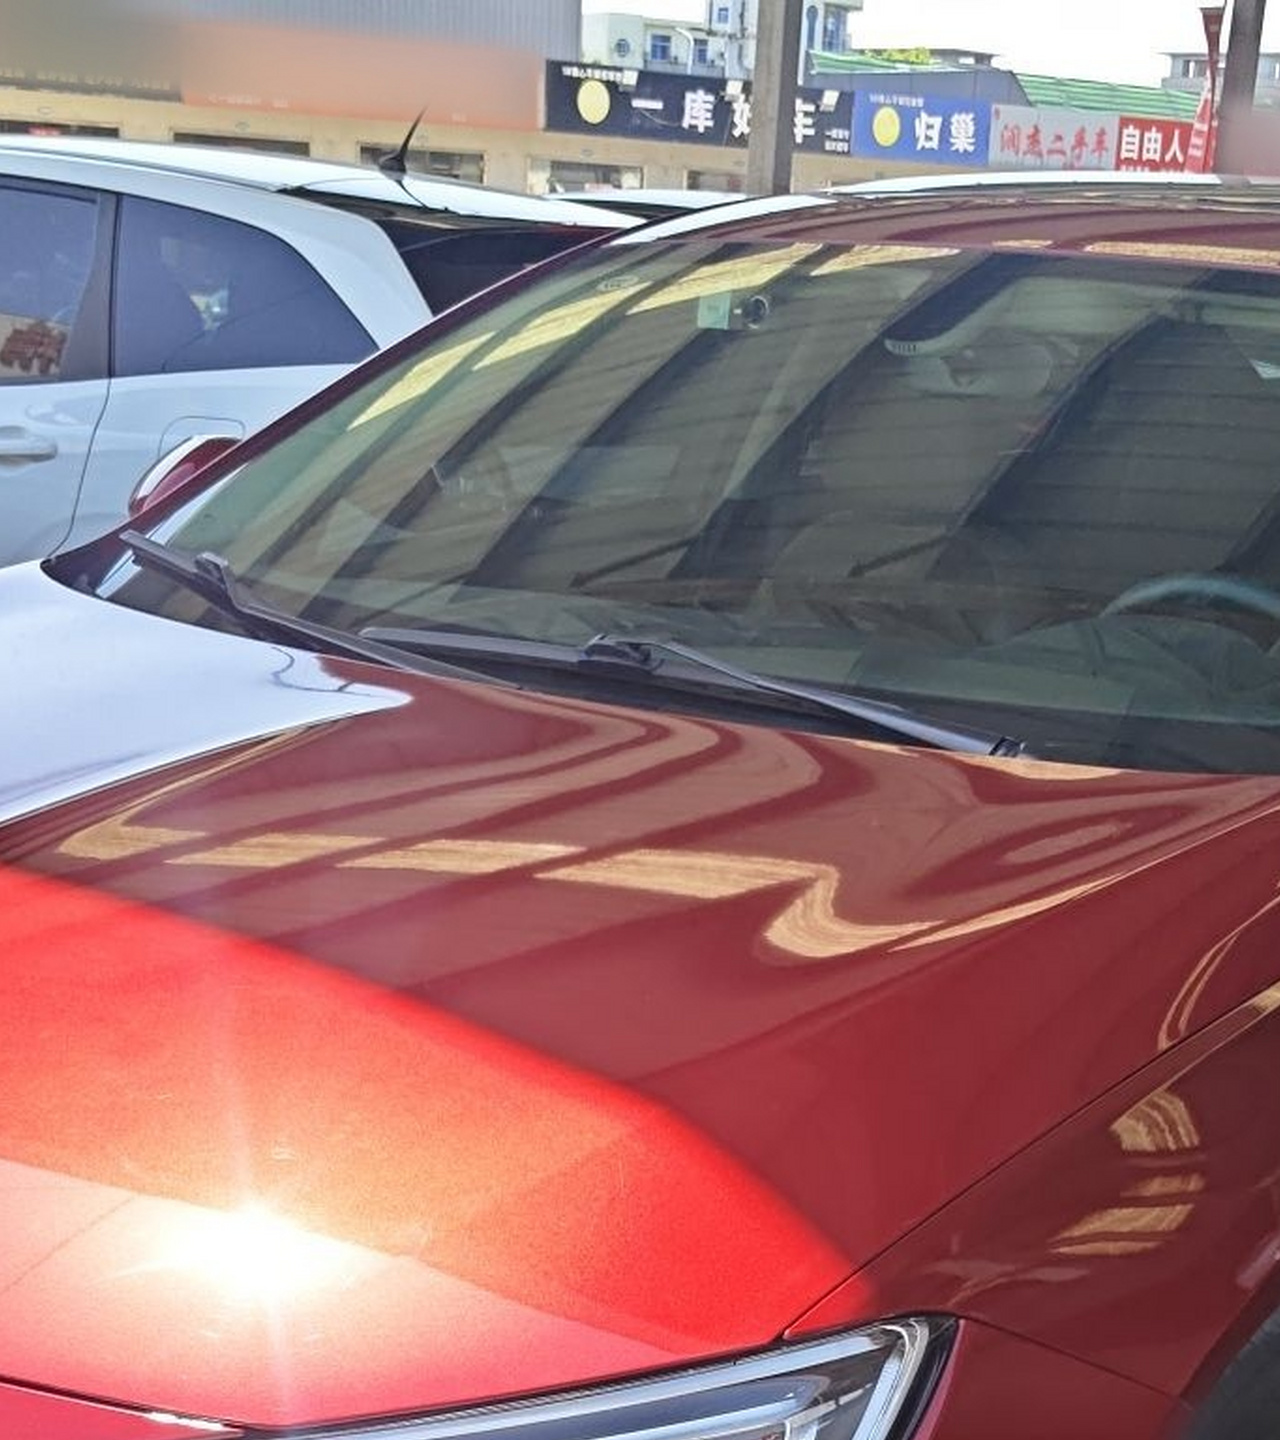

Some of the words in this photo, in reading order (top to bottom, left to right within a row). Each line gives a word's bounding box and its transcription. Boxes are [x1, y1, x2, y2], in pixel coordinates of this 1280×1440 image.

[914, 109, 976, 153] 归巢
[1120, 124, 1186, 164] 自由人
